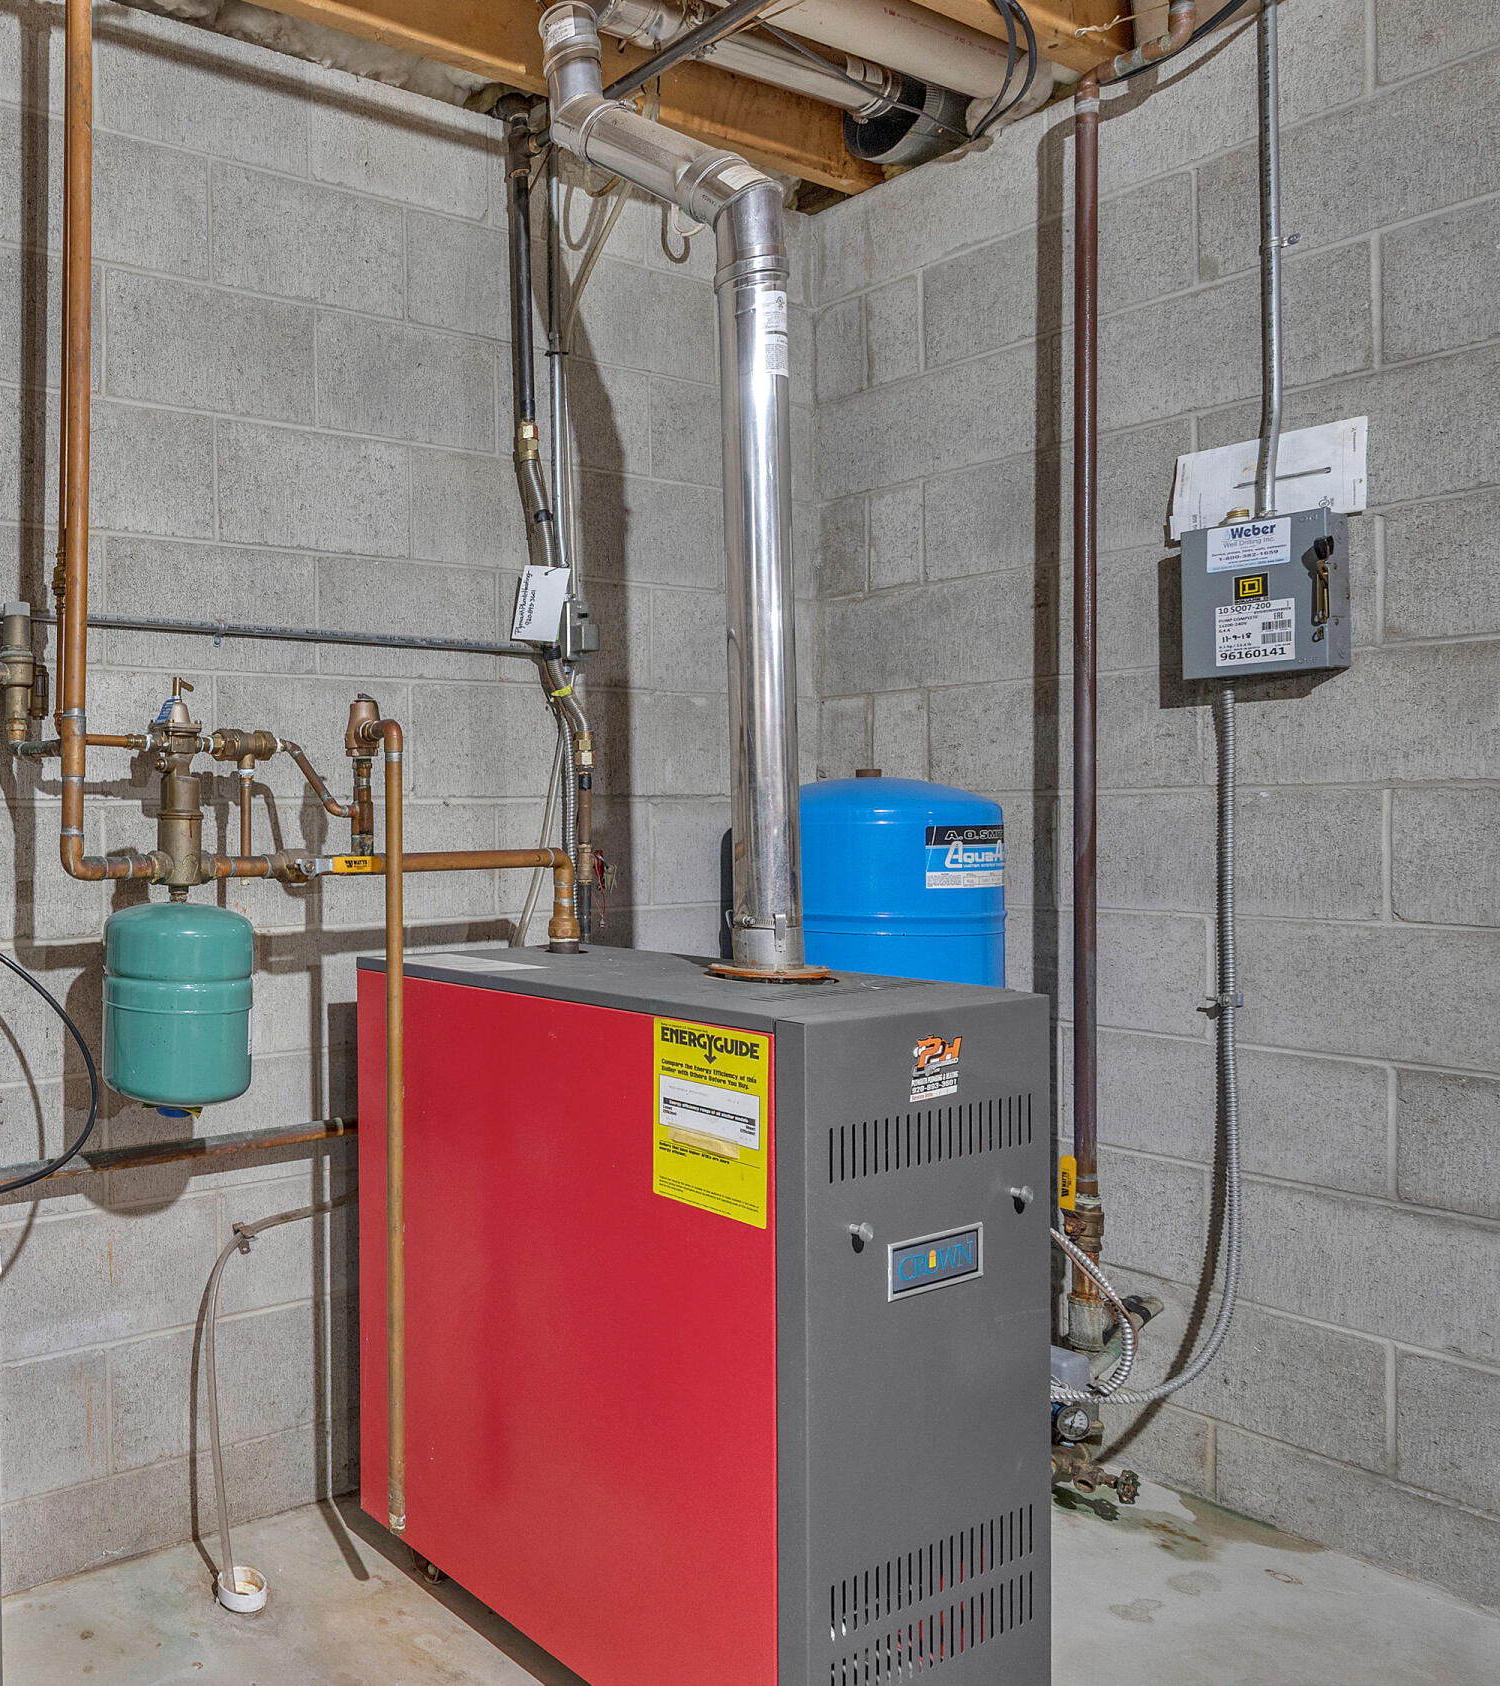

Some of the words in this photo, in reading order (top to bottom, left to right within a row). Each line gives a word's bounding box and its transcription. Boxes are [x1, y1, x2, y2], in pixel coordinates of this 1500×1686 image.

[1230, 524, 1276, 539] Weber
[1220, 646, 1286, 661] 96160141
[661, 1025, 760, 1061] ENERGYGUIDE
[694, 1065, 711, 1075] Energy
[899, 1240, 973, 1281] CROWN
